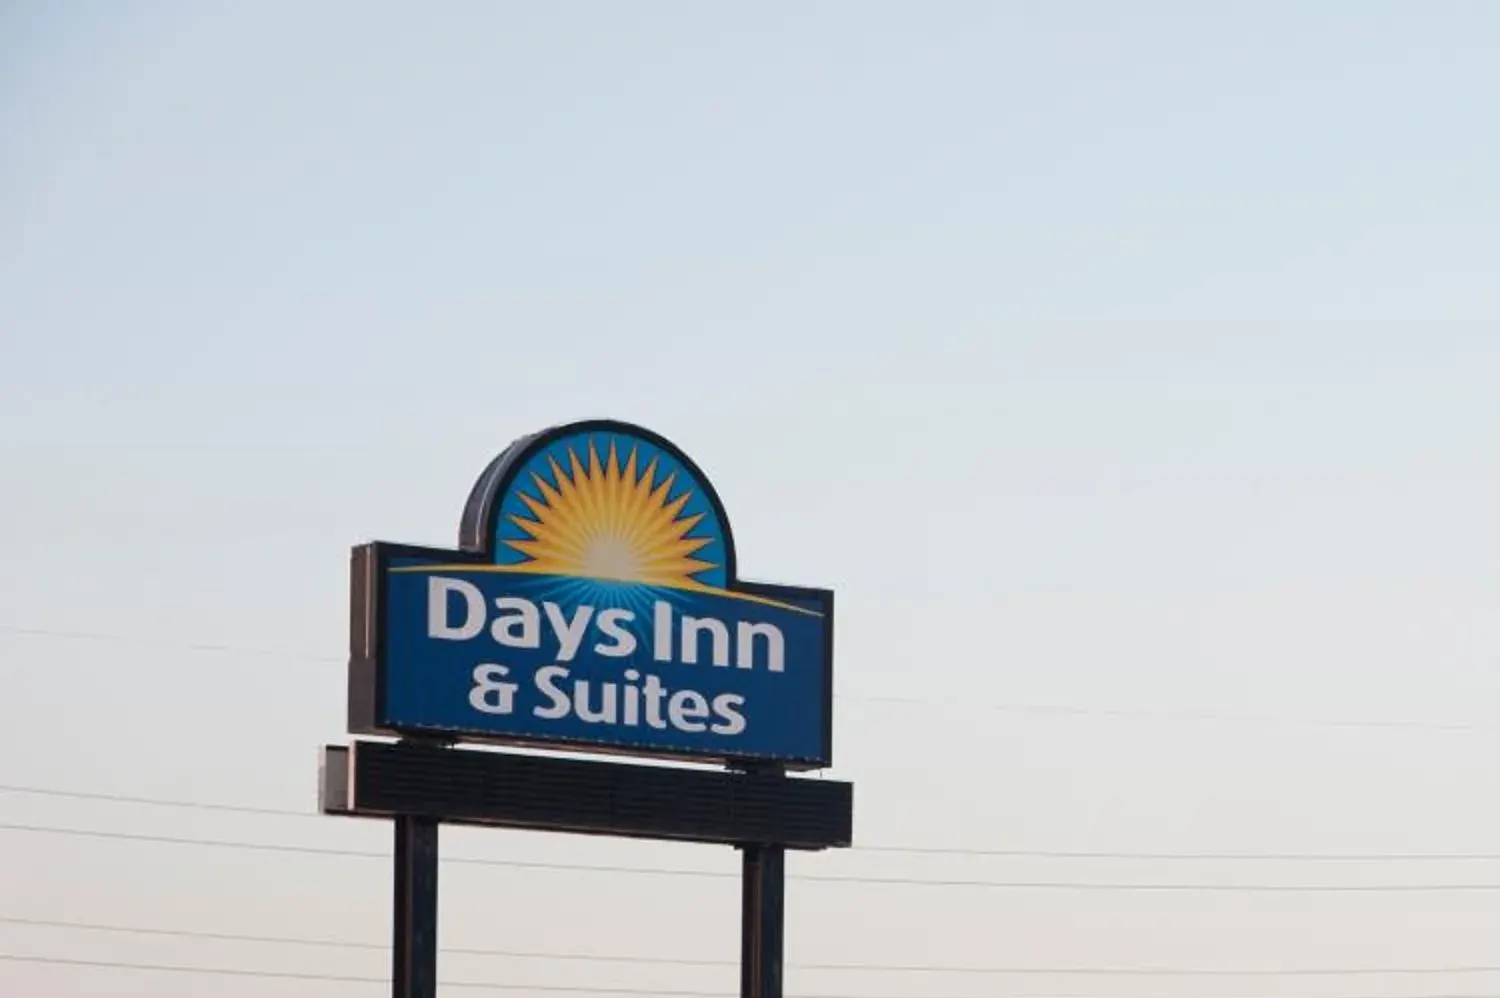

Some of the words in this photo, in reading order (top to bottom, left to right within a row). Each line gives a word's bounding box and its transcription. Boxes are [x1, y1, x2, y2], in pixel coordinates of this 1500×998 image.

[428, 576, 636, 662] Days
[653, 601, 785, 672] Inn
[468, 663, 518, 715] &
[533, 666, 747, 735] Suites
